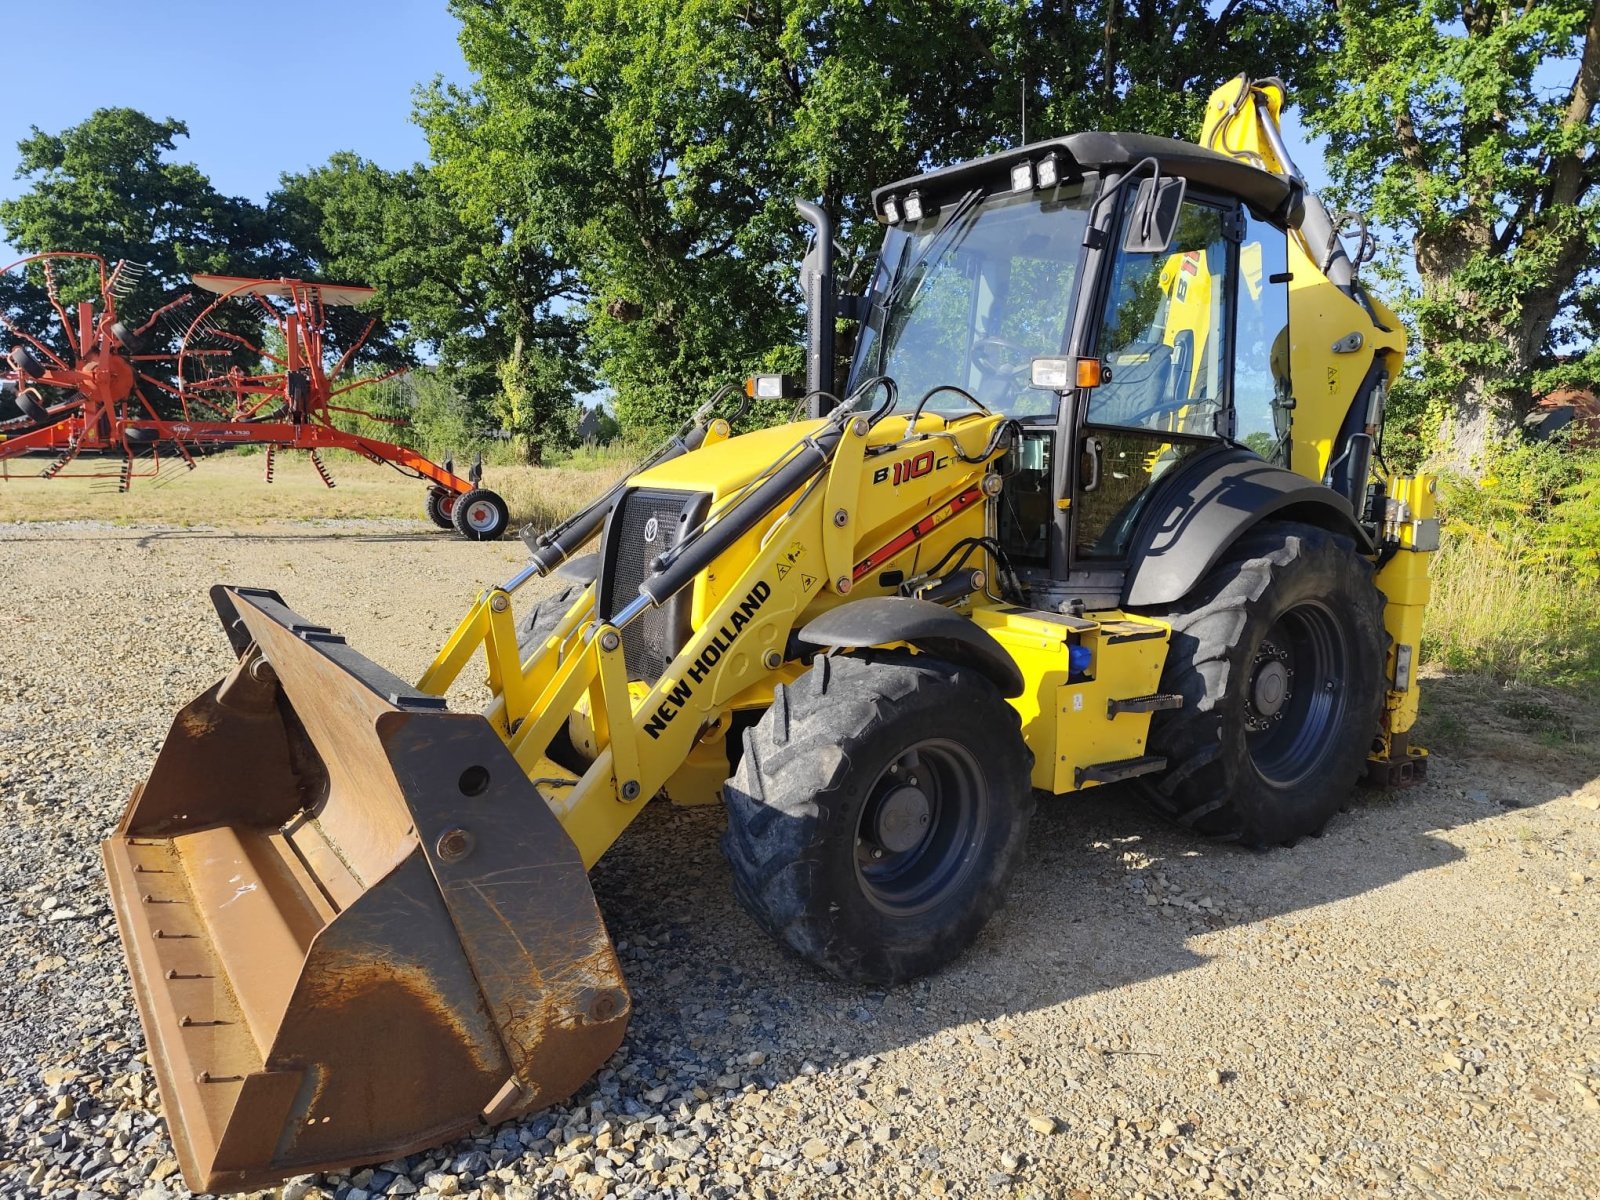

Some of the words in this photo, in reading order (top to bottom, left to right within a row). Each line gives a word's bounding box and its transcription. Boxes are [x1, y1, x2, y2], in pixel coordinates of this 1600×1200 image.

[872, 467, 889, 485] B
[893, 450, 935, 486] 110
[643, 679, 693, 740] NEW
[687, 580, 771, 685] HOLLAND
